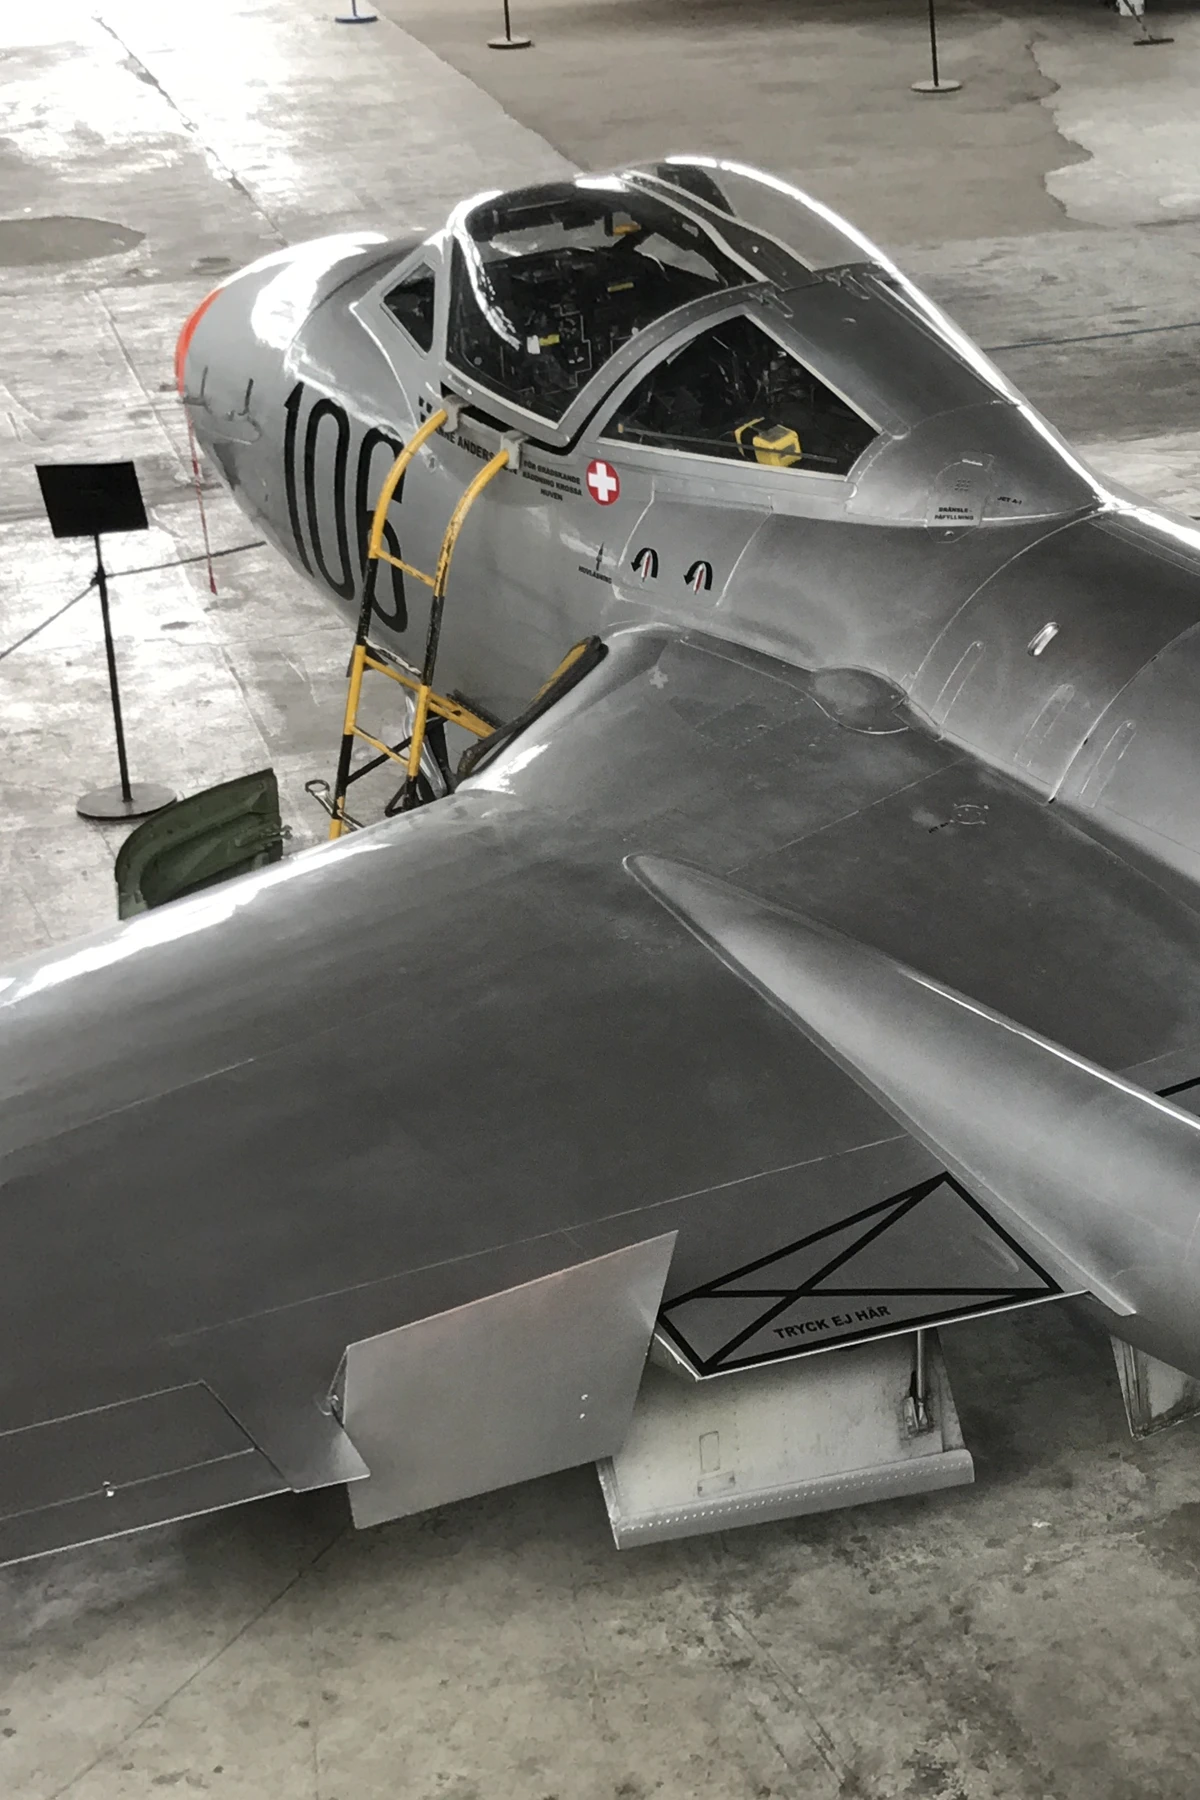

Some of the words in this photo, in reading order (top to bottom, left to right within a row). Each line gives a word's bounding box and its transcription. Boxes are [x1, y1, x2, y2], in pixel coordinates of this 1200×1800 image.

[284, 381, 408, 633] 106
[773, 1318, 830, 1339] TRYCK
[831, 1313, 853, 1327] EJ
[854, 1305, 892, 1322] HÄR
